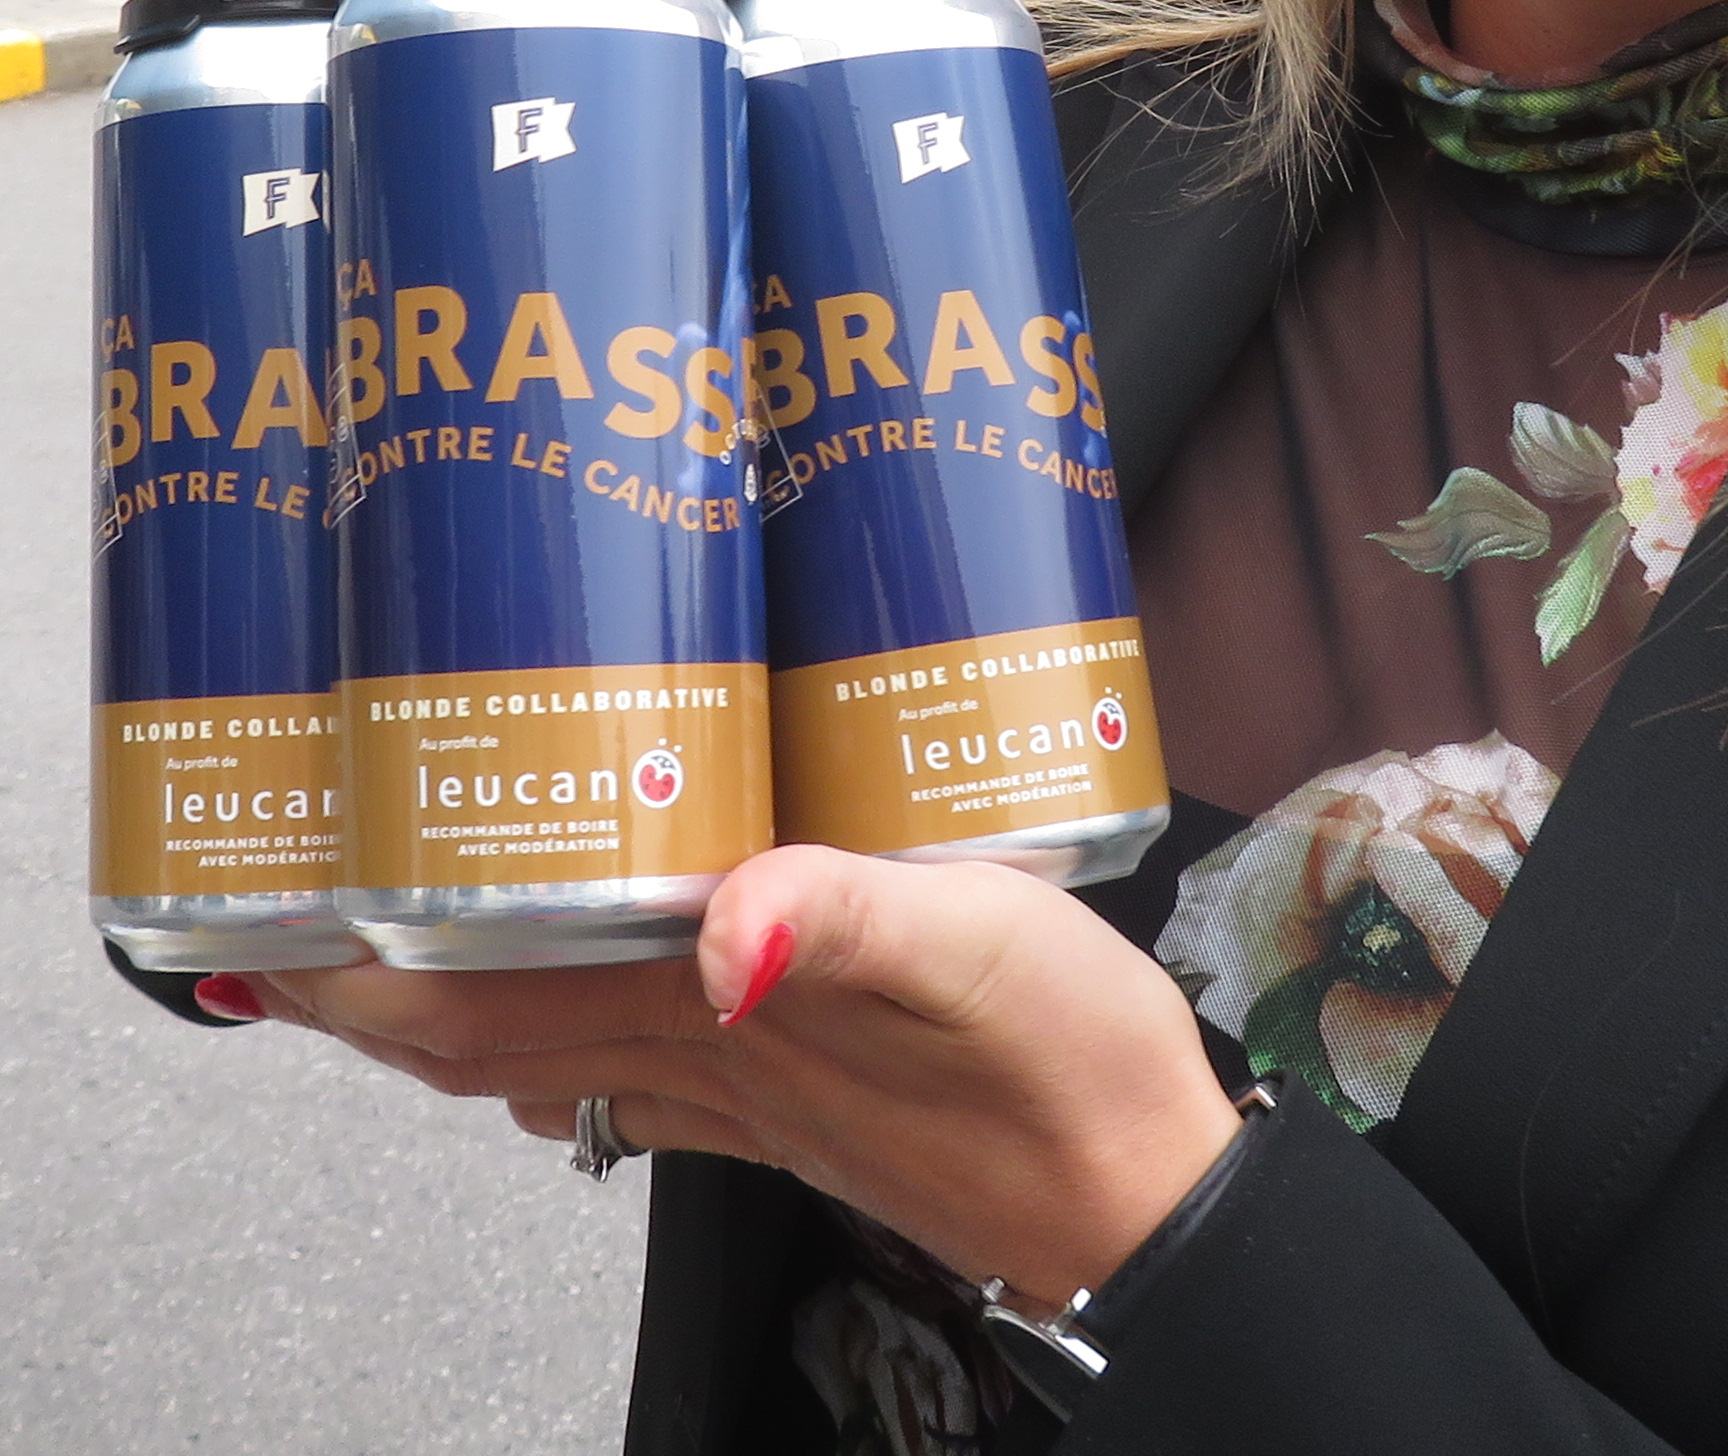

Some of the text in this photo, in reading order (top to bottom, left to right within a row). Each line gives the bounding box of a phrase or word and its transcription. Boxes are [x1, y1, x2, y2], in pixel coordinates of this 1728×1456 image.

[515, 108, 543, 154] F
[917, 122, 938, 165] F
[265, 178, 290, 220] F
[766, 417, 937, 503] CONTRE
[954, 419, 1006, 458] LE
[342, 425, 495, 500] CONTRE
[510, 432, 572, 479] LE
[583, 459, 741, 533] CANCER
[254, 478, 310, 519] LE
[835, 666, 949, 702] BLONDE
[370, 687, 730, 723] BLONDE COLLABORATIVE
[898, 698, 980, 722] Au profit de
[122, 720, 214, 743] BLONDE
[418, 735, 500, 753] Au profit de
[900, 718, 1086, 775] leucan
[165, 755, 239, 772] Au profit de
[418, 764, 619, 809] leucan
[911, 763, 1089, 802] RECOMMANDE DE BOIRE
[951, 780, 1093, 814] AVEC MODÉRATION
[166, 836, 269, 852] RECOMMANDE
[274, 835, 295, 849] DE
[421, 819, 619, 840] RECOMMANDE DE BOIRE
[457, 836, 621, 857] AVEC MODÉRATION
[198, 853, 238, 868] AVEC
